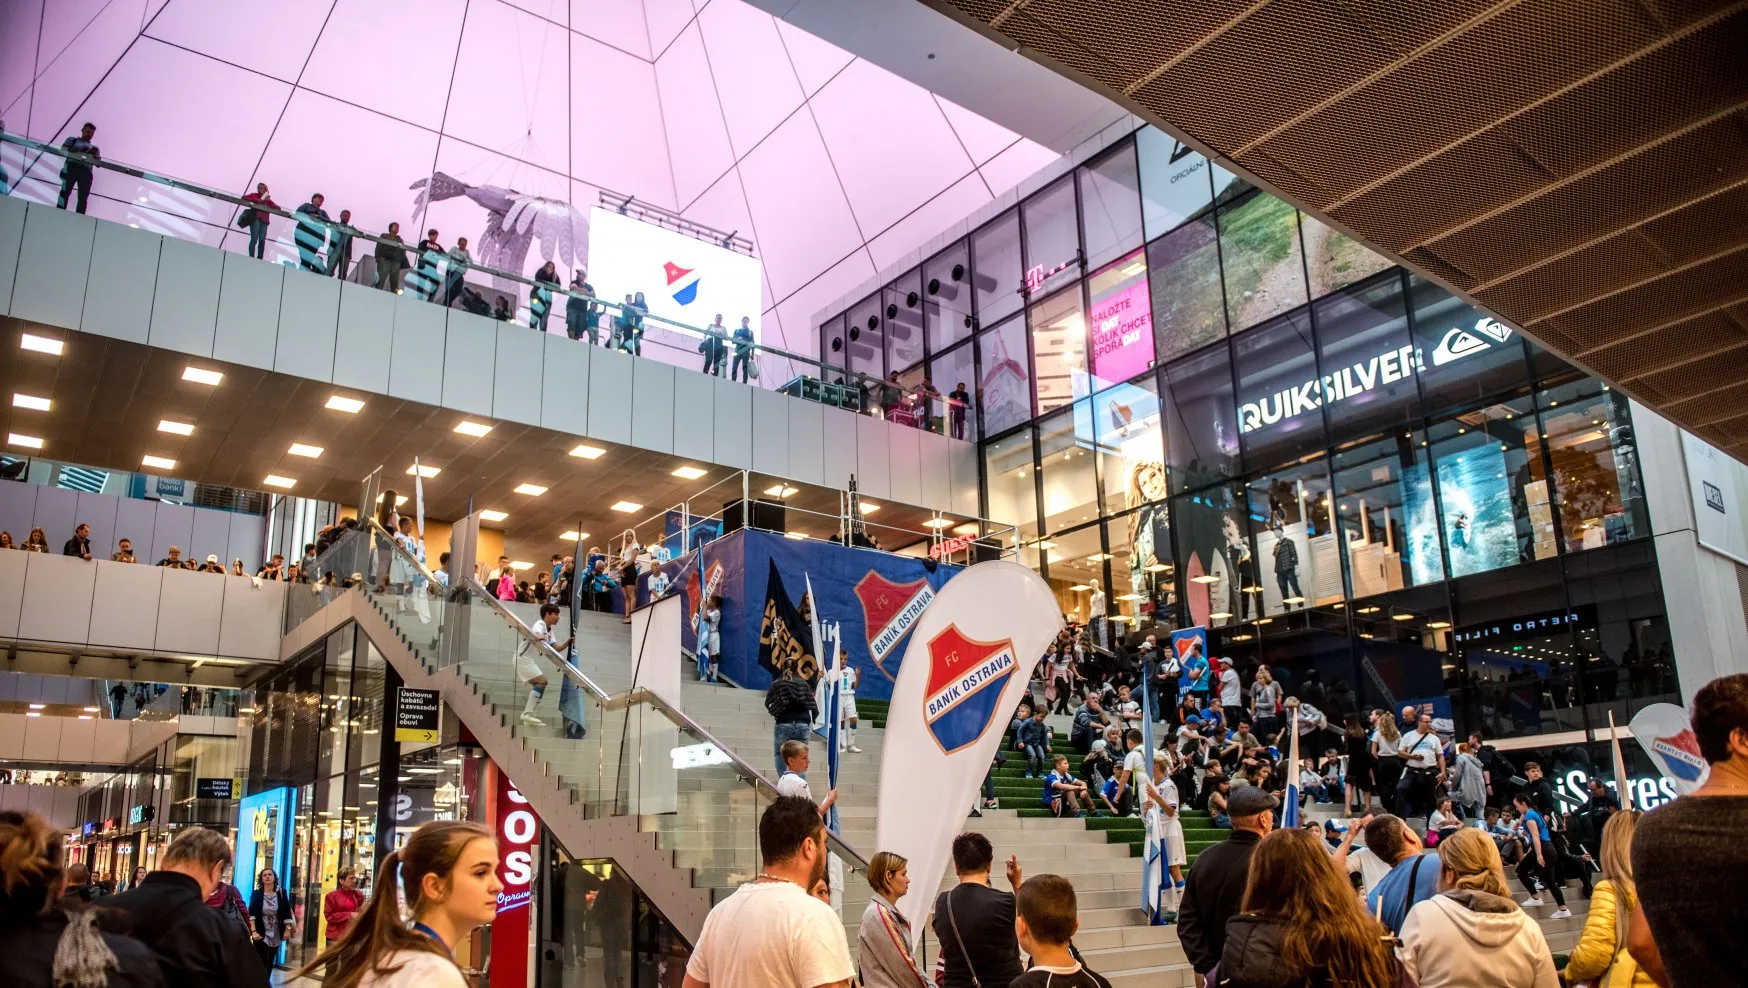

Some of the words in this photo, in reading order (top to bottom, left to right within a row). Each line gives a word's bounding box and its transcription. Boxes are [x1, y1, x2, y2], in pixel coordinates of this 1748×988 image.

[1236, 344, 1427, 434] QUIKSILVER
[875, 594, 889, 610] FC
[874, 627, 900, 655] BANÍK
[898, 591, 932, 629] OSTRAVA
[945, 650, 959, 668] FC
[401, 690, 432, 698] Úschovna
[929, 685, 960, 715] BANÍK
[962, 653, 1012, 691] OSTRAVA
